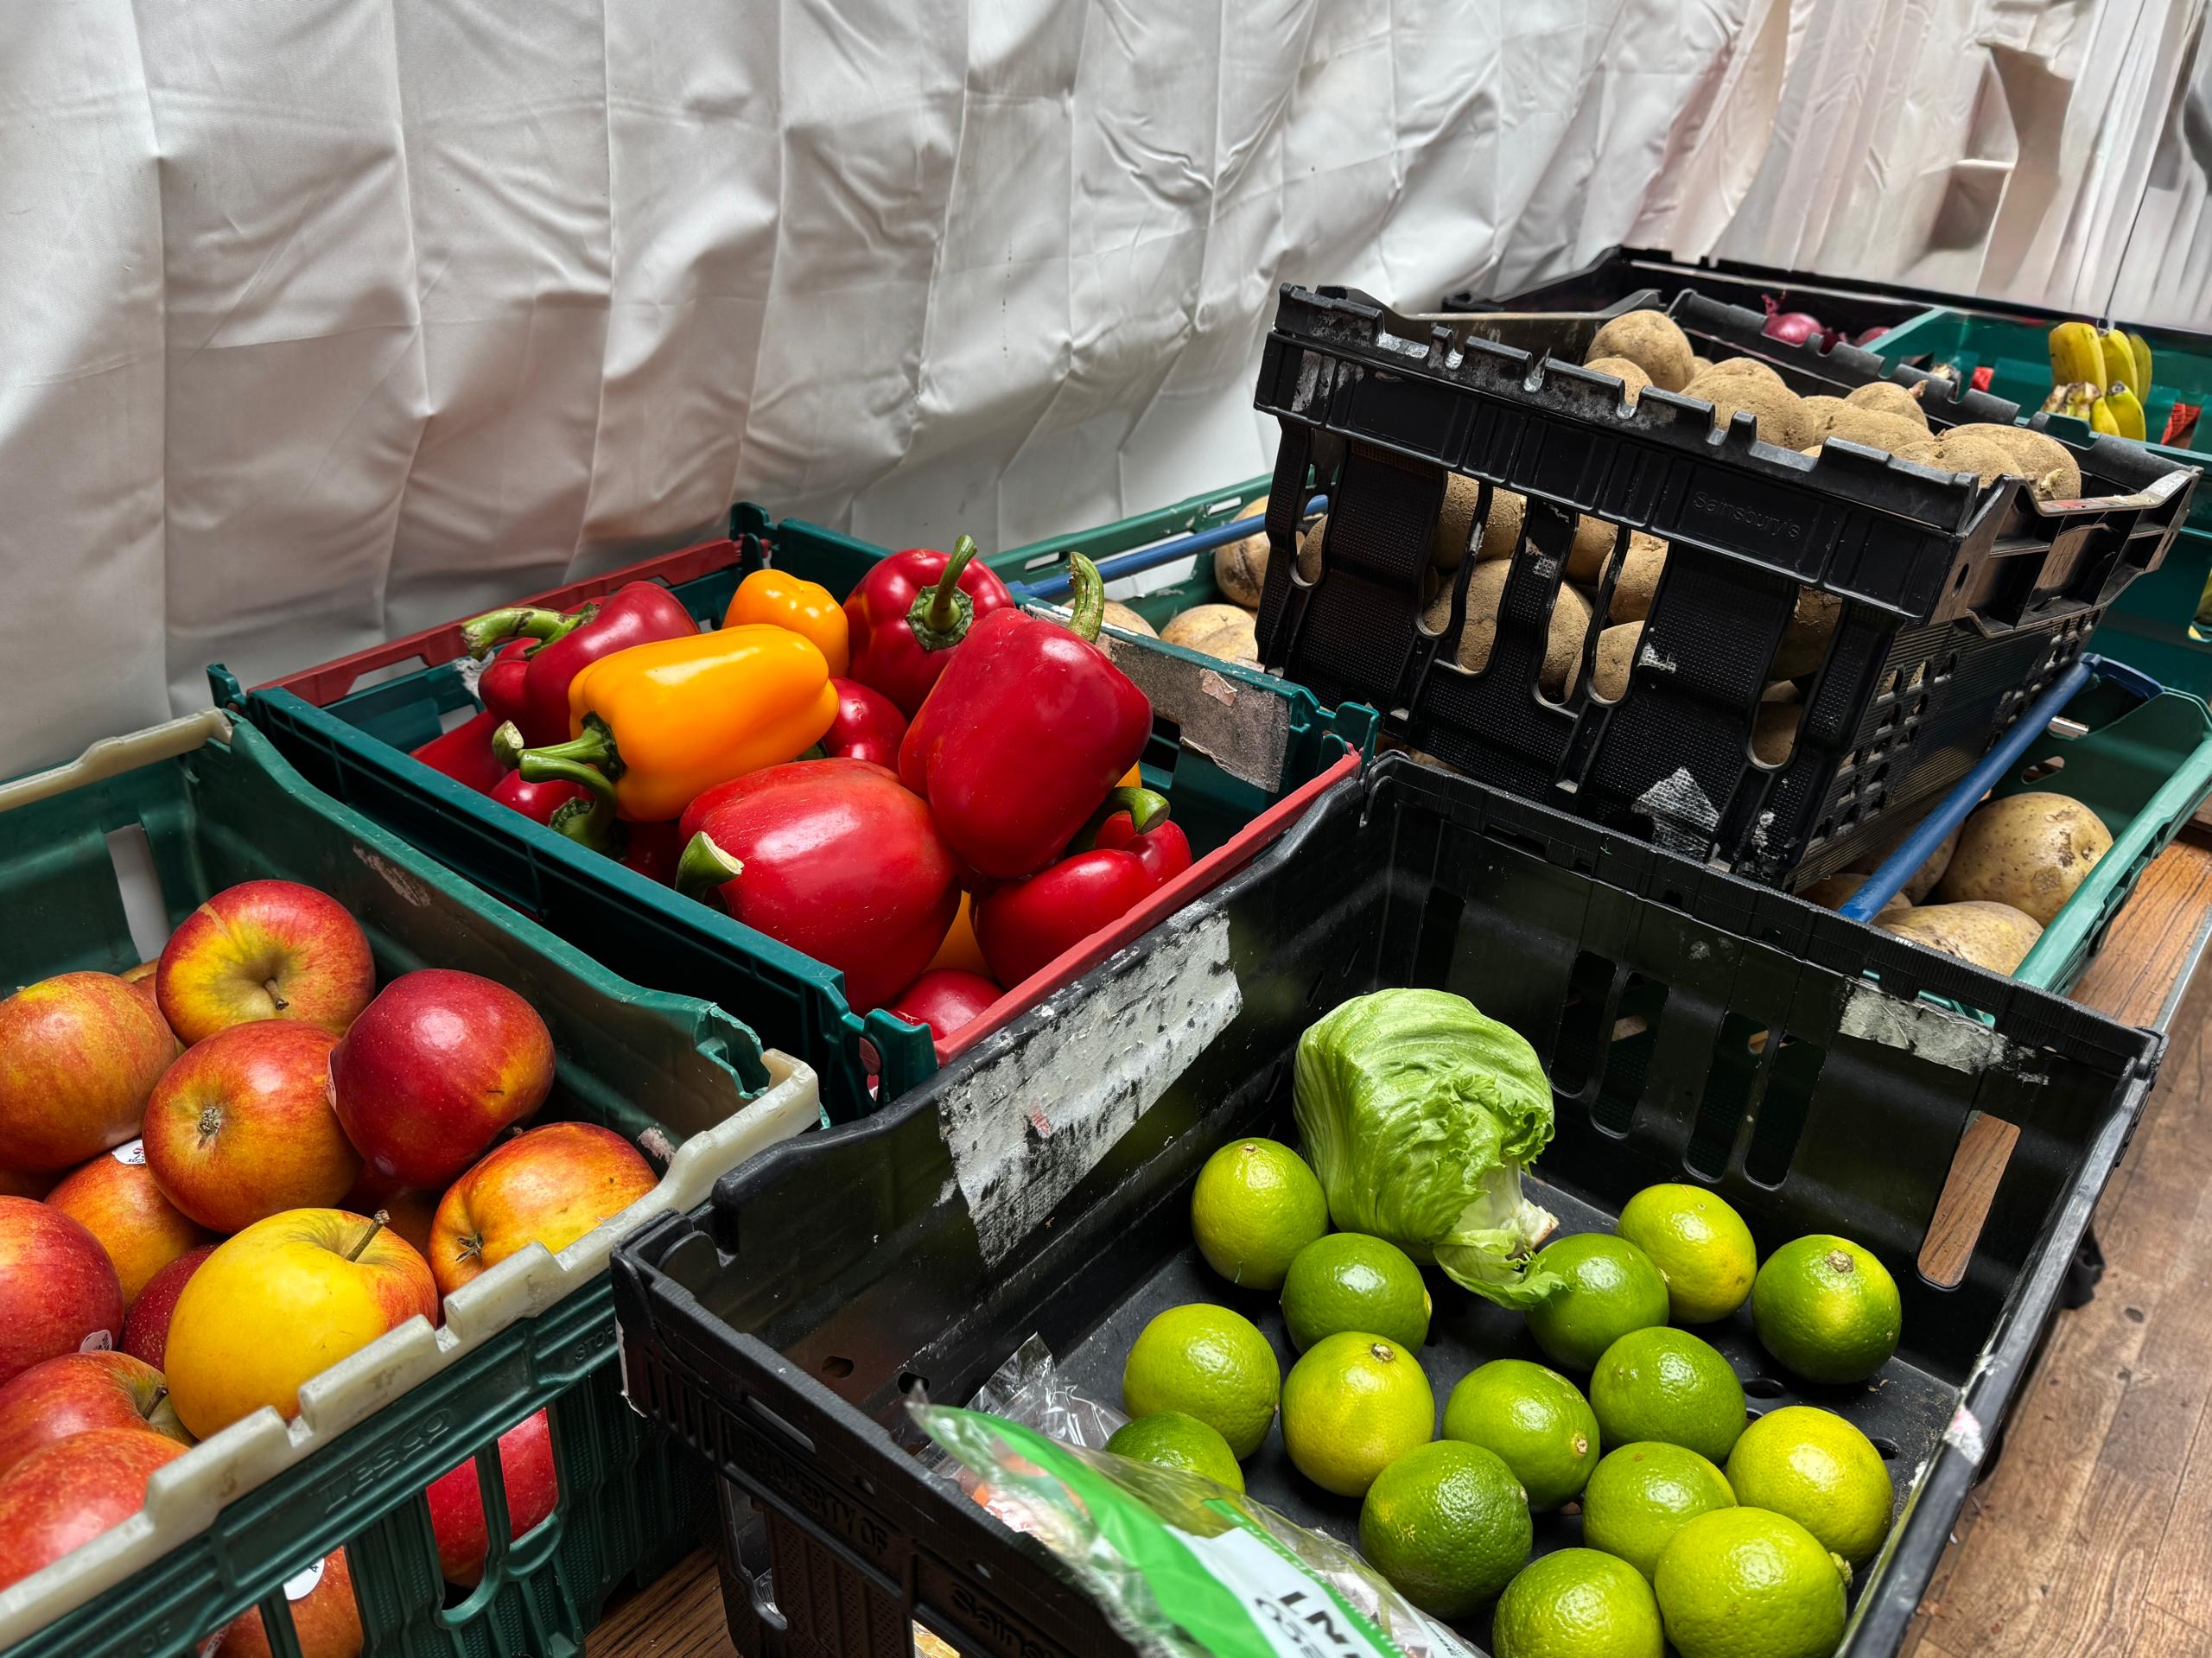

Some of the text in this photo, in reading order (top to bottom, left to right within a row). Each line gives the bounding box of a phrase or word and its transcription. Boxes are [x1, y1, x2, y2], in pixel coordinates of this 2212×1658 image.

[1692, 490, 1802, 538] Sainsbury's
[575, 1323, 616, 1362] STOR
[314, 1407, 451, 1515] TESCO
[747, 1435, 888, 1556] PROPERTY OF
[951, 1582, 1052, 1658] Sains
